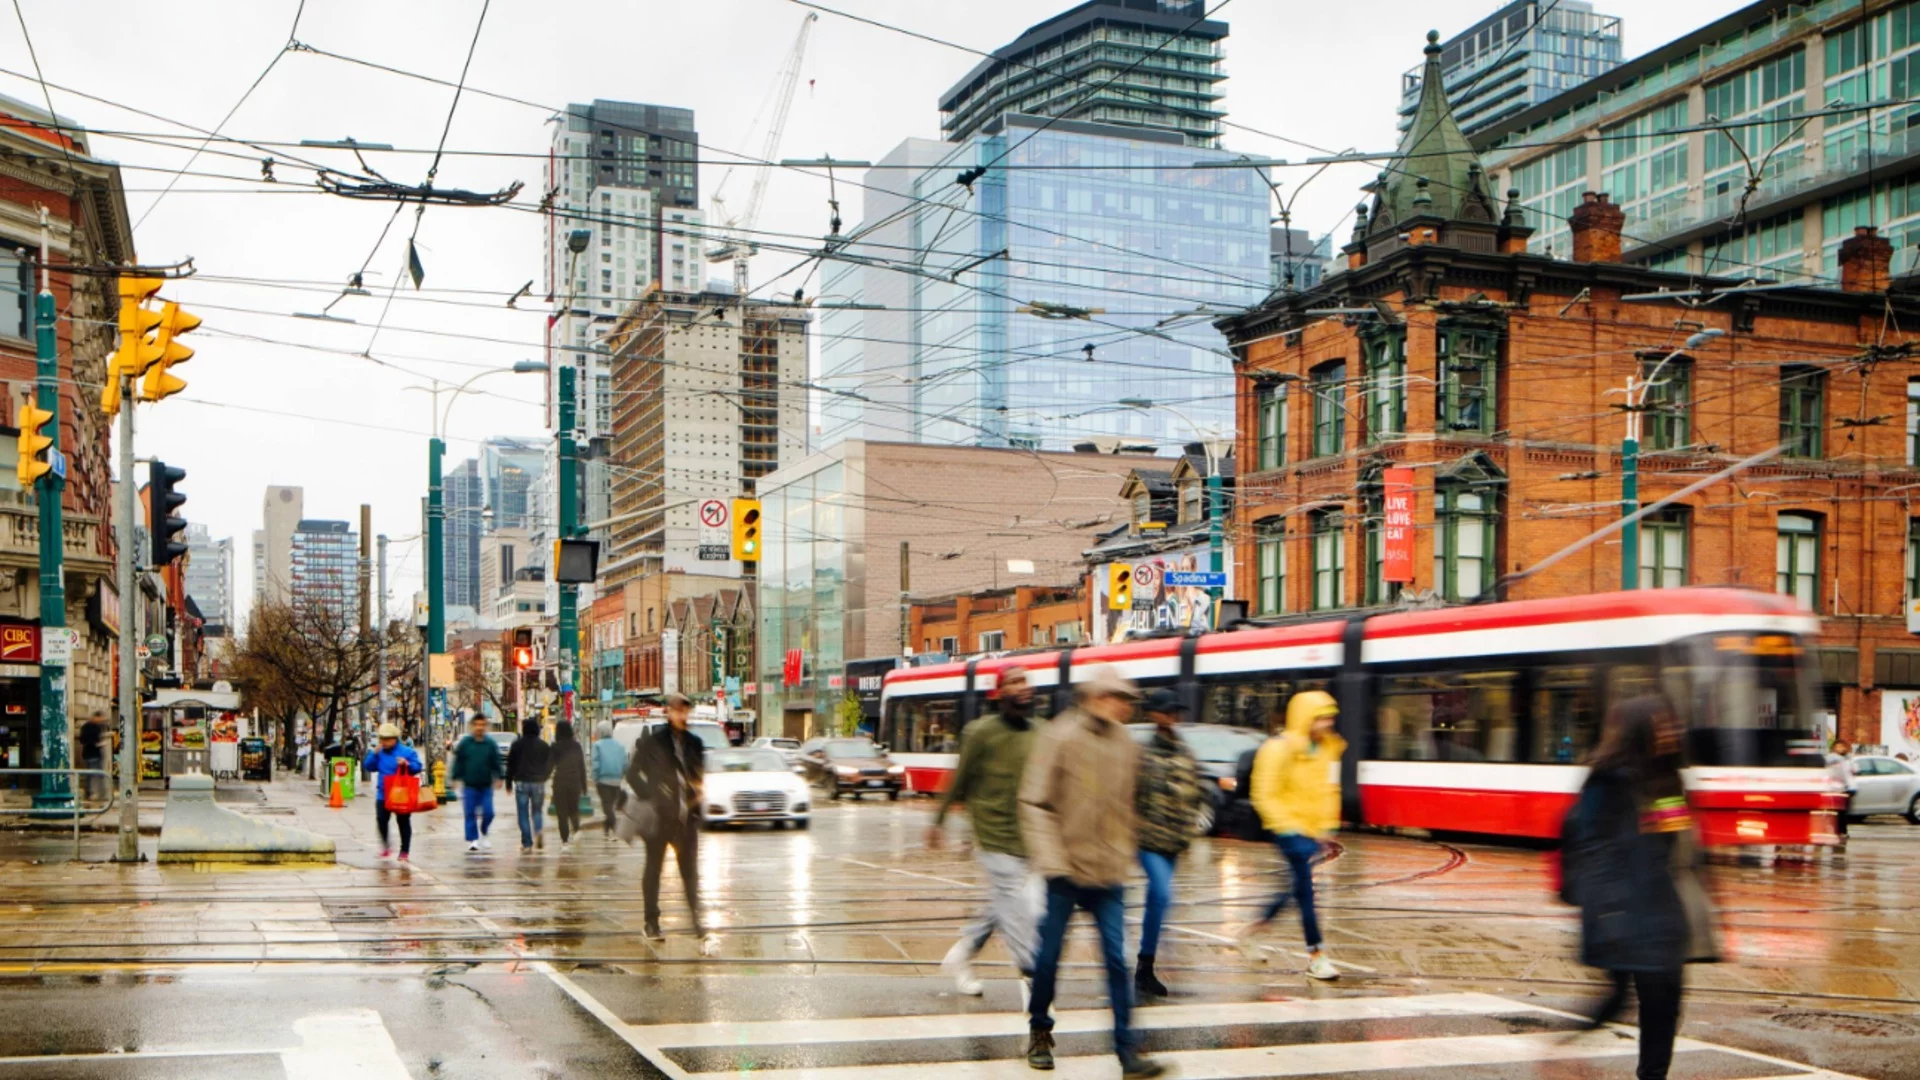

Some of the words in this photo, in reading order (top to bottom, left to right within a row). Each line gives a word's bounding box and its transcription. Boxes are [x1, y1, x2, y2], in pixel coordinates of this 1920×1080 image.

[1387, 497, 1408, 510] LIVE
[1387, 512, 1411, 526] LOVE
[1387, 527, 1404, 540] EAT
[1172, 572, 1207, 584] Spadina
[4, 628, 31, 643] CIBC
